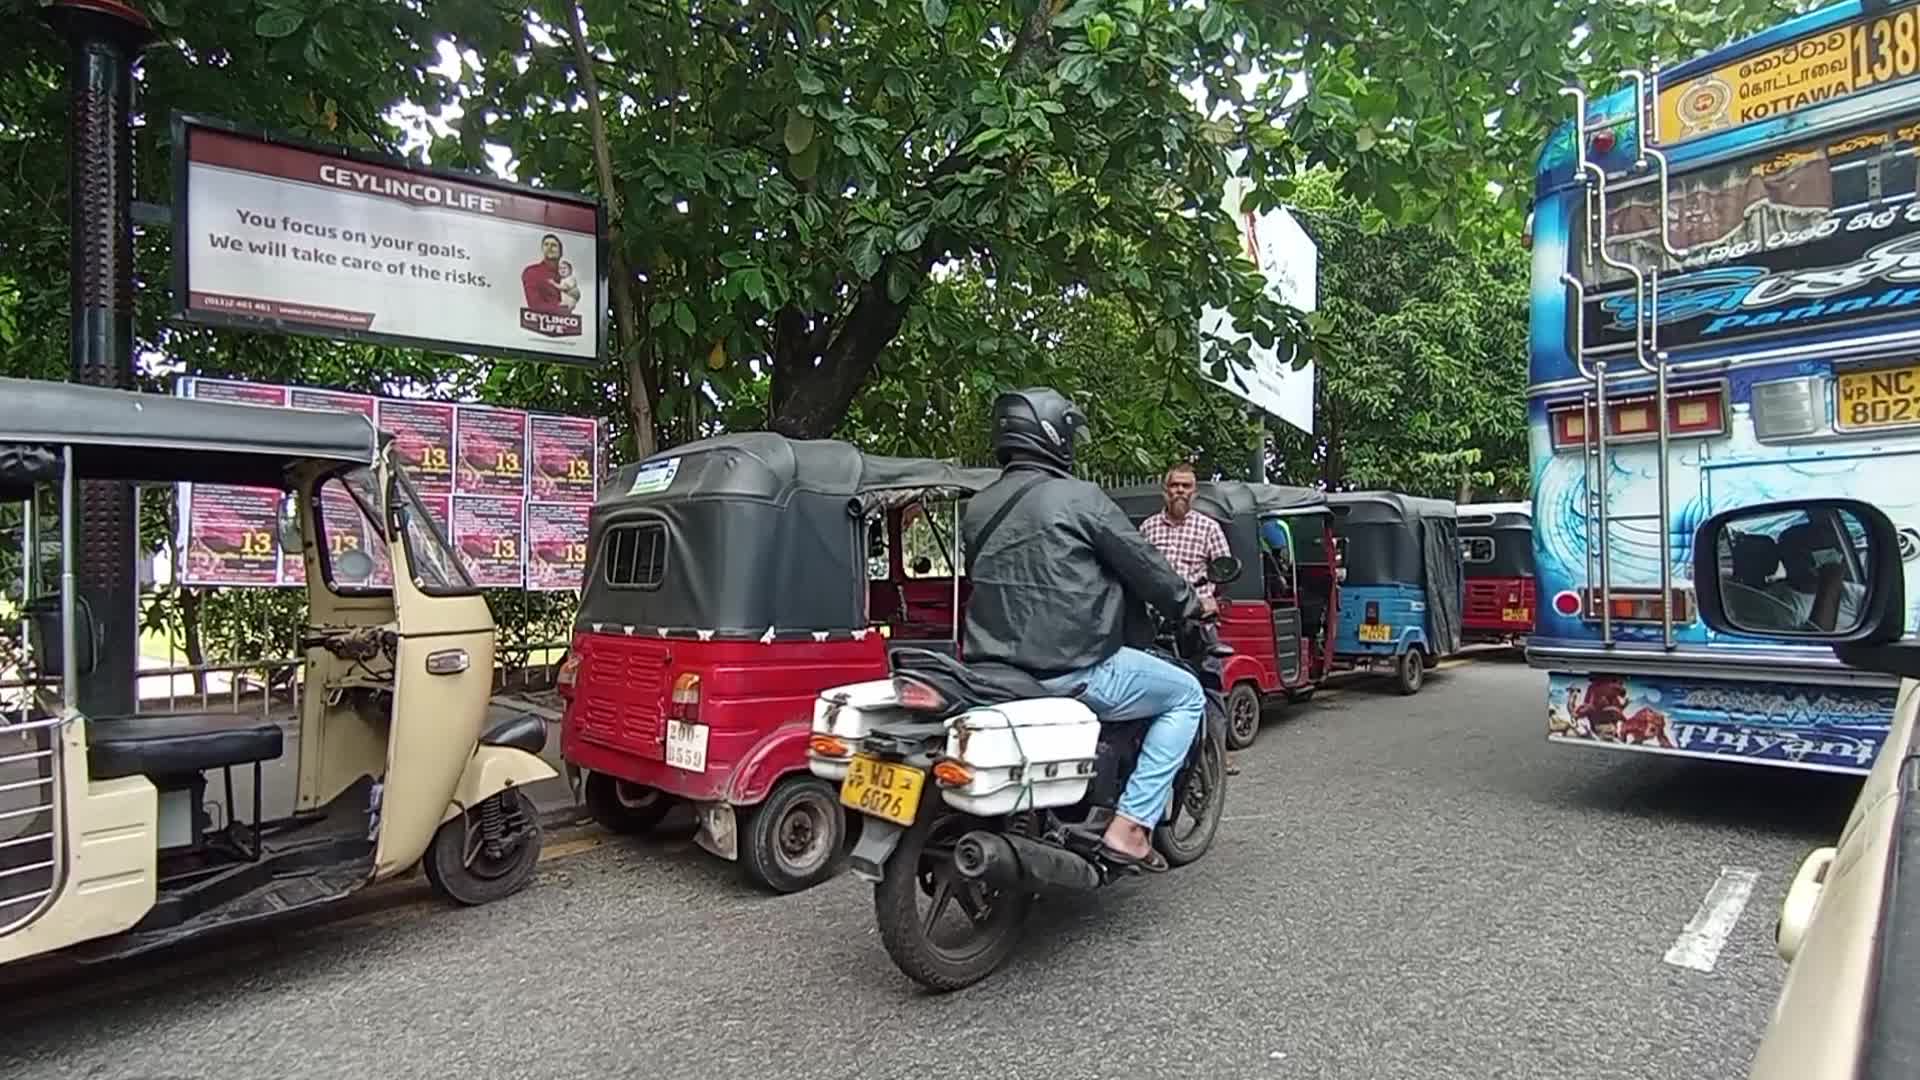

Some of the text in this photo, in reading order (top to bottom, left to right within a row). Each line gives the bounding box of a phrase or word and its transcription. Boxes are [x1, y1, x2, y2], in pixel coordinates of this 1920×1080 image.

[1854, 11, 1917, 89] 138
[1741, 81, 1849, 123] KOTTAWA
[319, 164, 496, 213] CEYLINCO LIFE
[236, 207, 471, 261] You focus on your goals.
[208, 232, 492, 289] We will take care of the risks.
[524, 311, 579, 328] CEYLINCO
[540, 321, 565, 334] LIFE
[1871, 370, 1916, 397] NC
[1851, 397, 1920, 425] 802
[421, 447, 447, 467] 13
[495, 452, 519, 472] 13
[566, 459, 590, 479] 13
[241, 531, 272, 554] 13
[491, 539, 516, 559] 13
[565, 544, 587, 563] 13
[859, 787, 904, 818] 6076
